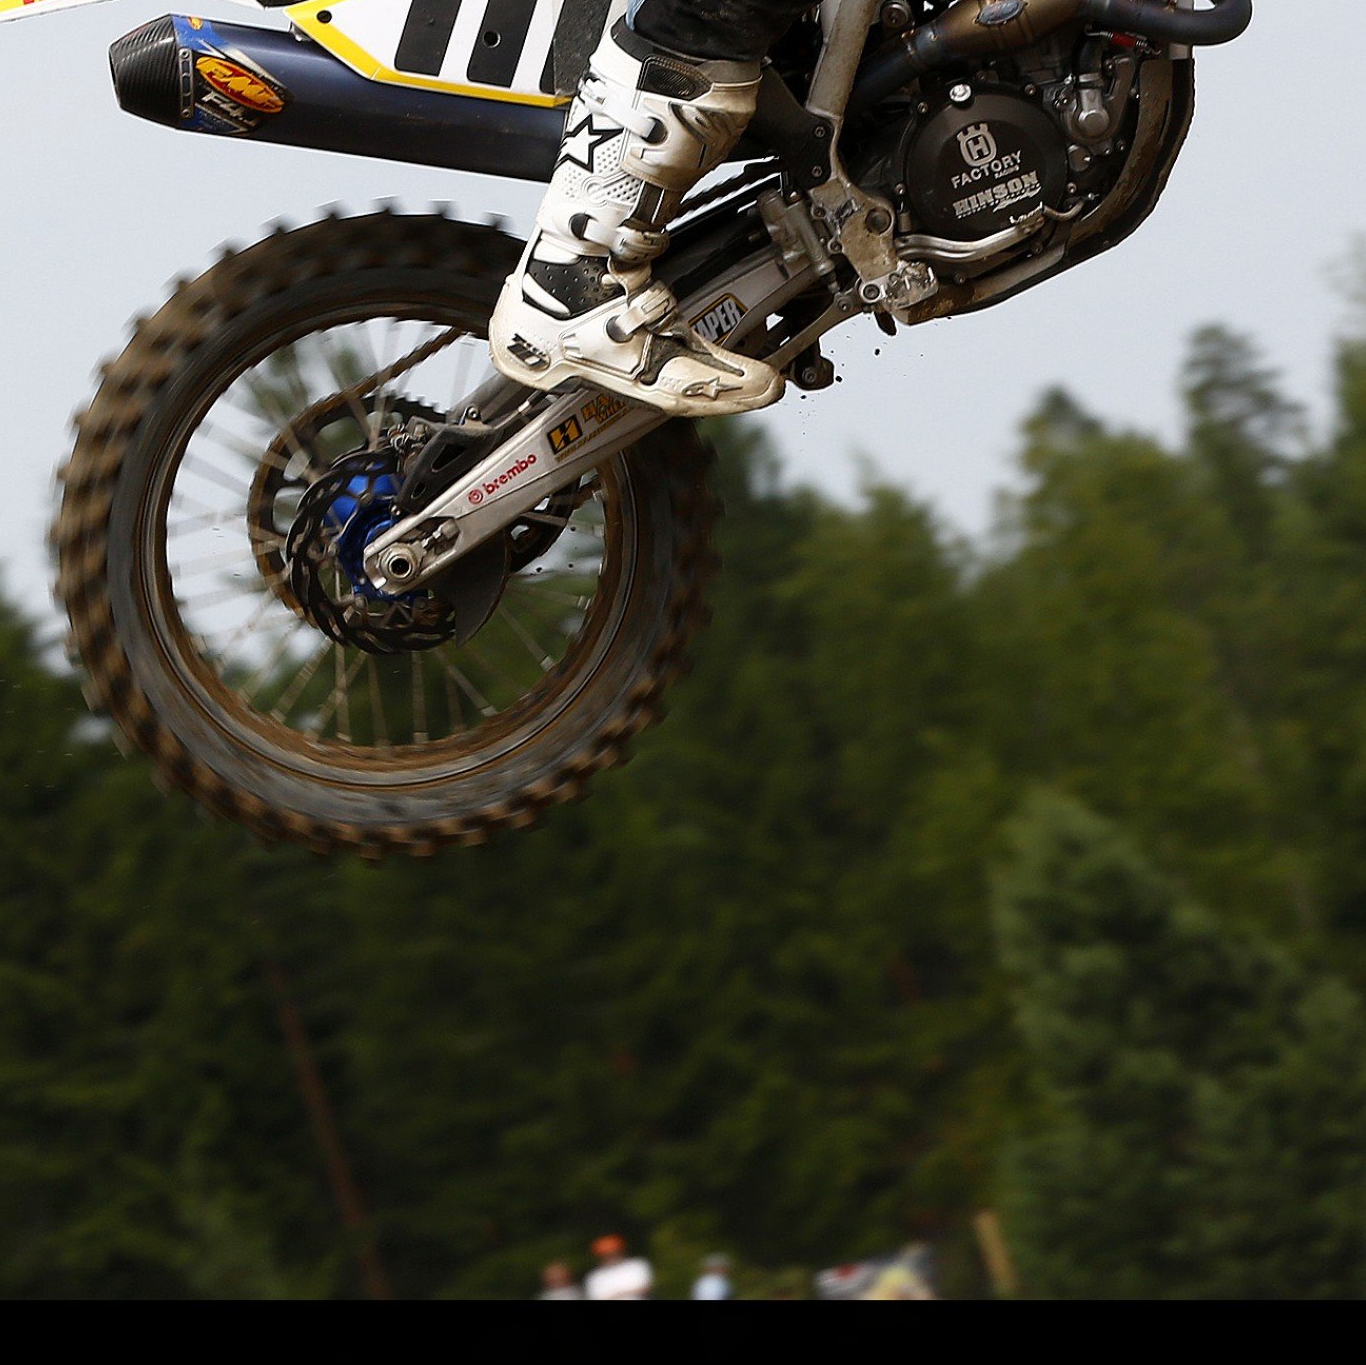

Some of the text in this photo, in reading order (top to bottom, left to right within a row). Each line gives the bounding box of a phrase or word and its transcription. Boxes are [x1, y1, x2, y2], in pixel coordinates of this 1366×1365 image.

[950, 150, 1022, 189] FACTORY
[953, 170, 1039, 215] HINSON
[482, 454, 537, 495] brembo
